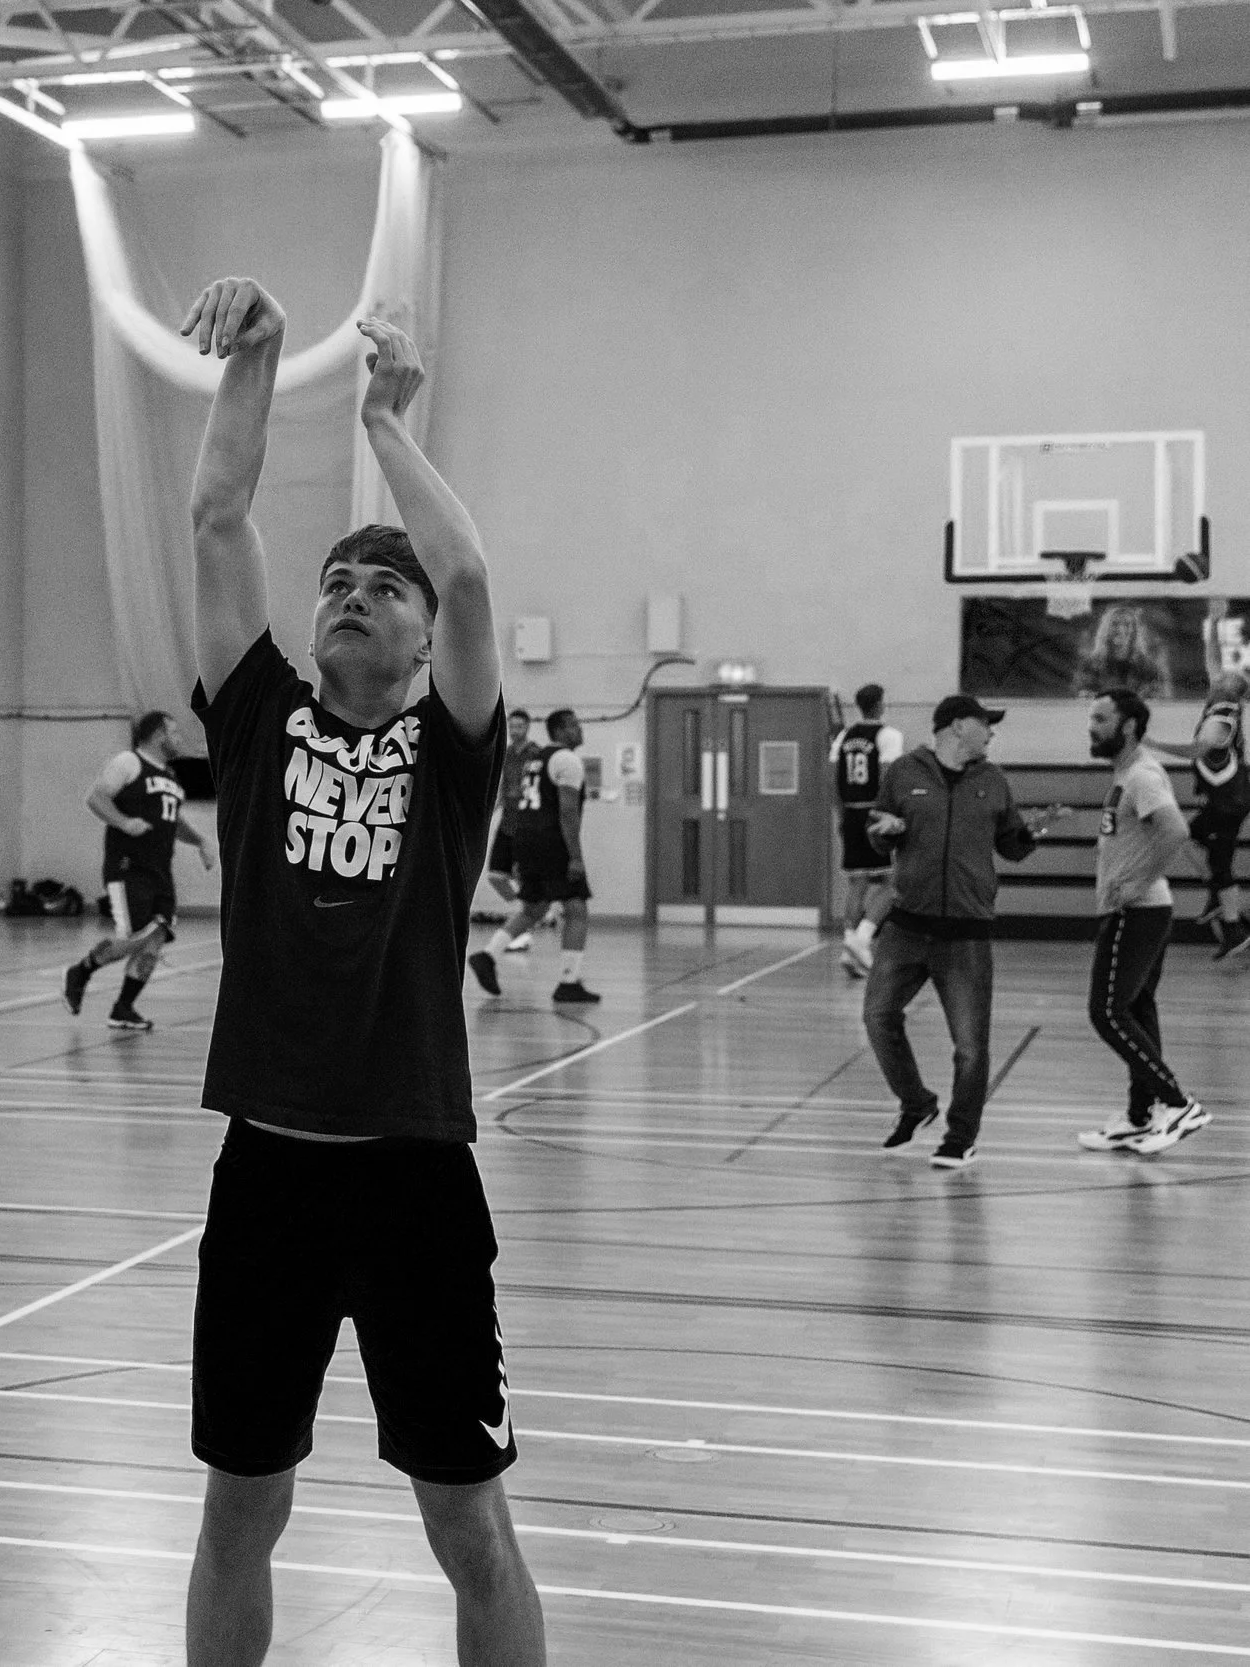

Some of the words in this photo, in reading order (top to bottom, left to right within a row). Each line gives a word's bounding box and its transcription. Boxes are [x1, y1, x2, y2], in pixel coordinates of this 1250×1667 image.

[284, 747, 415, 825] NEVER
[846, 752, 869, 785] 18
[285, 811, 403, 881] STOP
